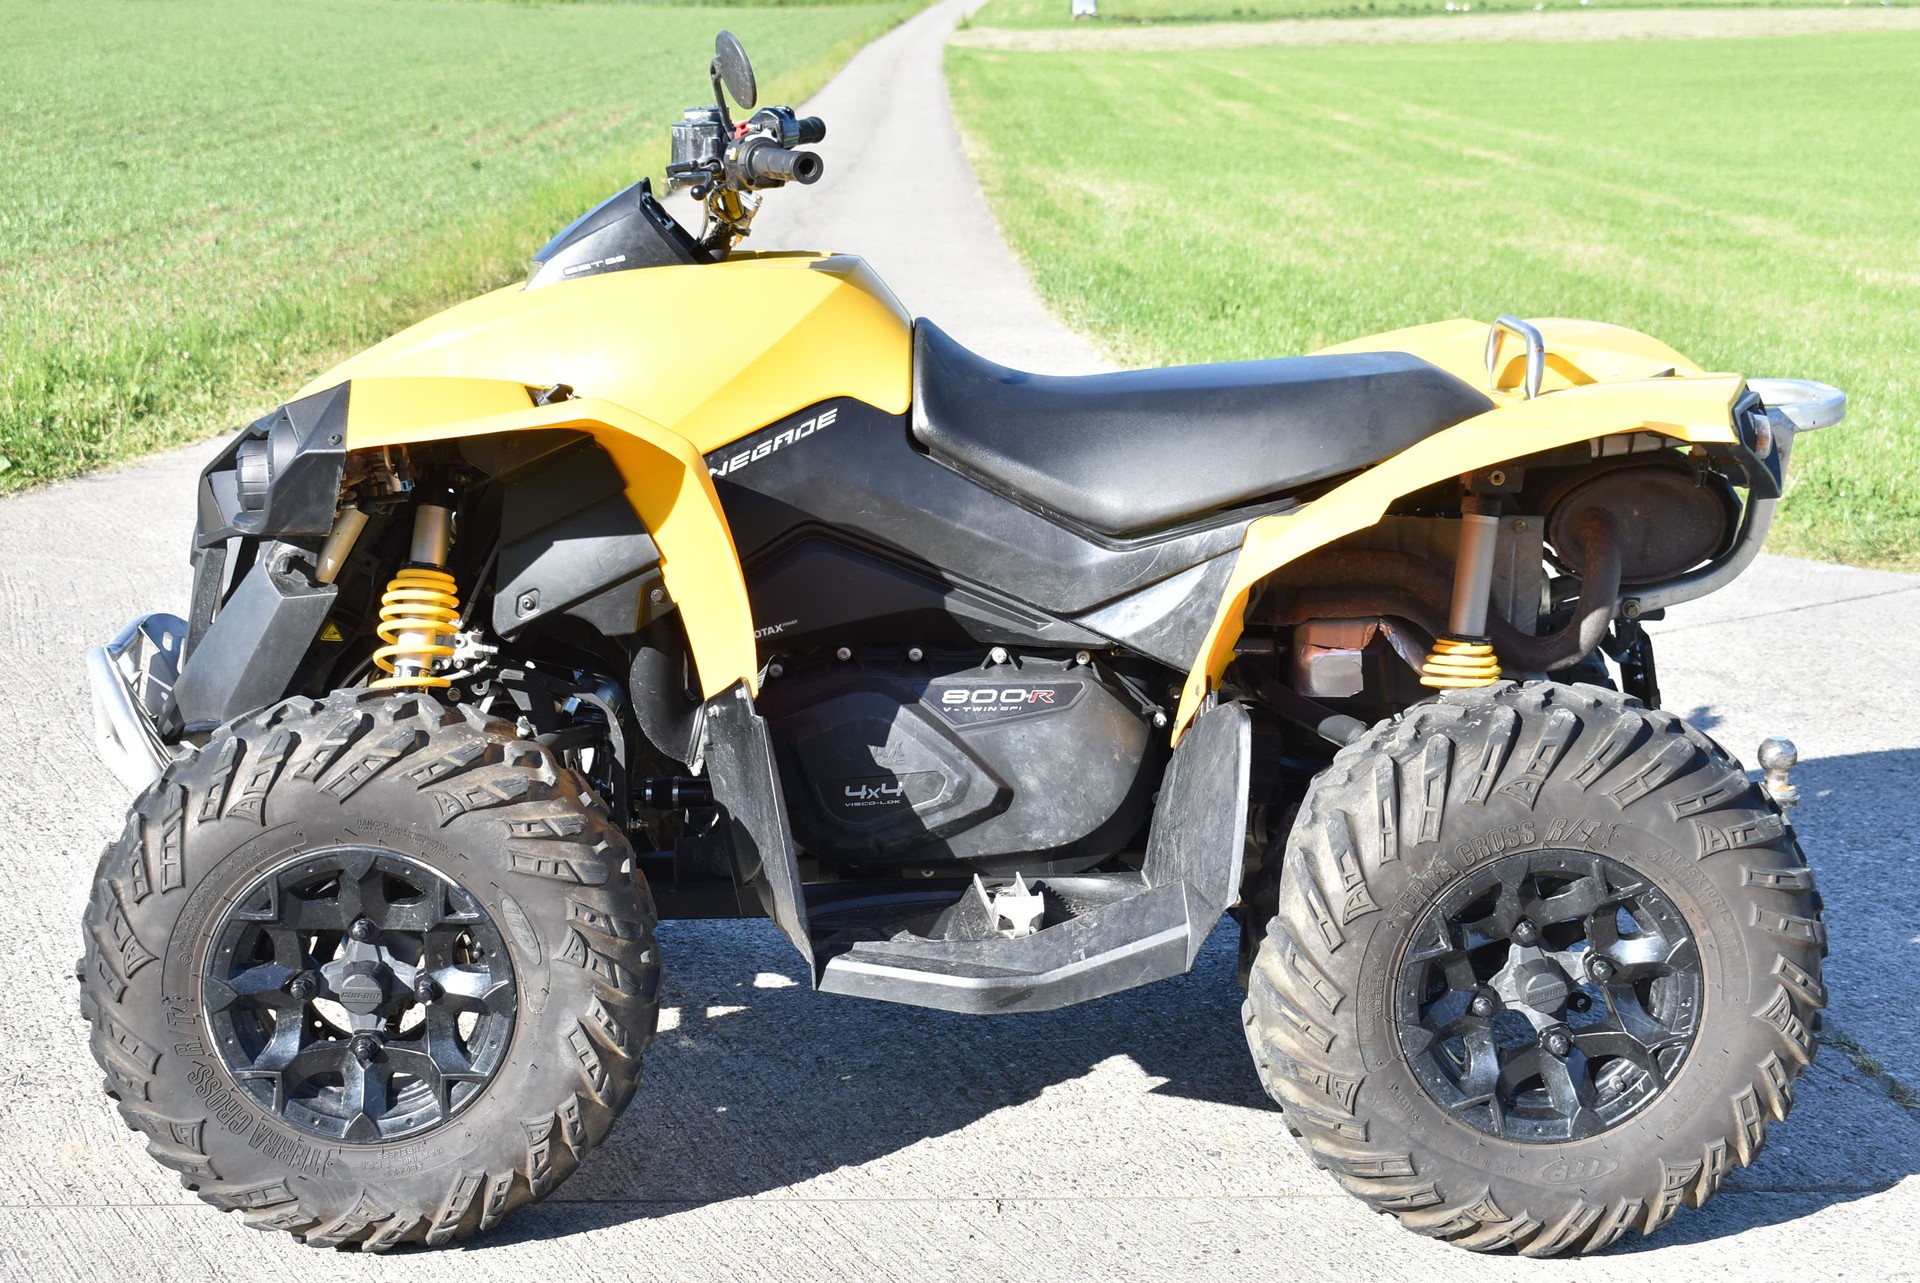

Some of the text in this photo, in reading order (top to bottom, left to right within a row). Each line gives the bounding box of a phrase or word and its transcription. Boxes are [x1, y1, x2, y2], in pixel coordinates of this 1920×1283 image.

[941, 689, 1055, 704] 800R
[1389, 856, 1459, 921] TERRA
[1454, 819, 1537, 868] CROSS
[187, 1061, 254, 1136] CROSS
[248, 1122, 322, 1175] TERRA
